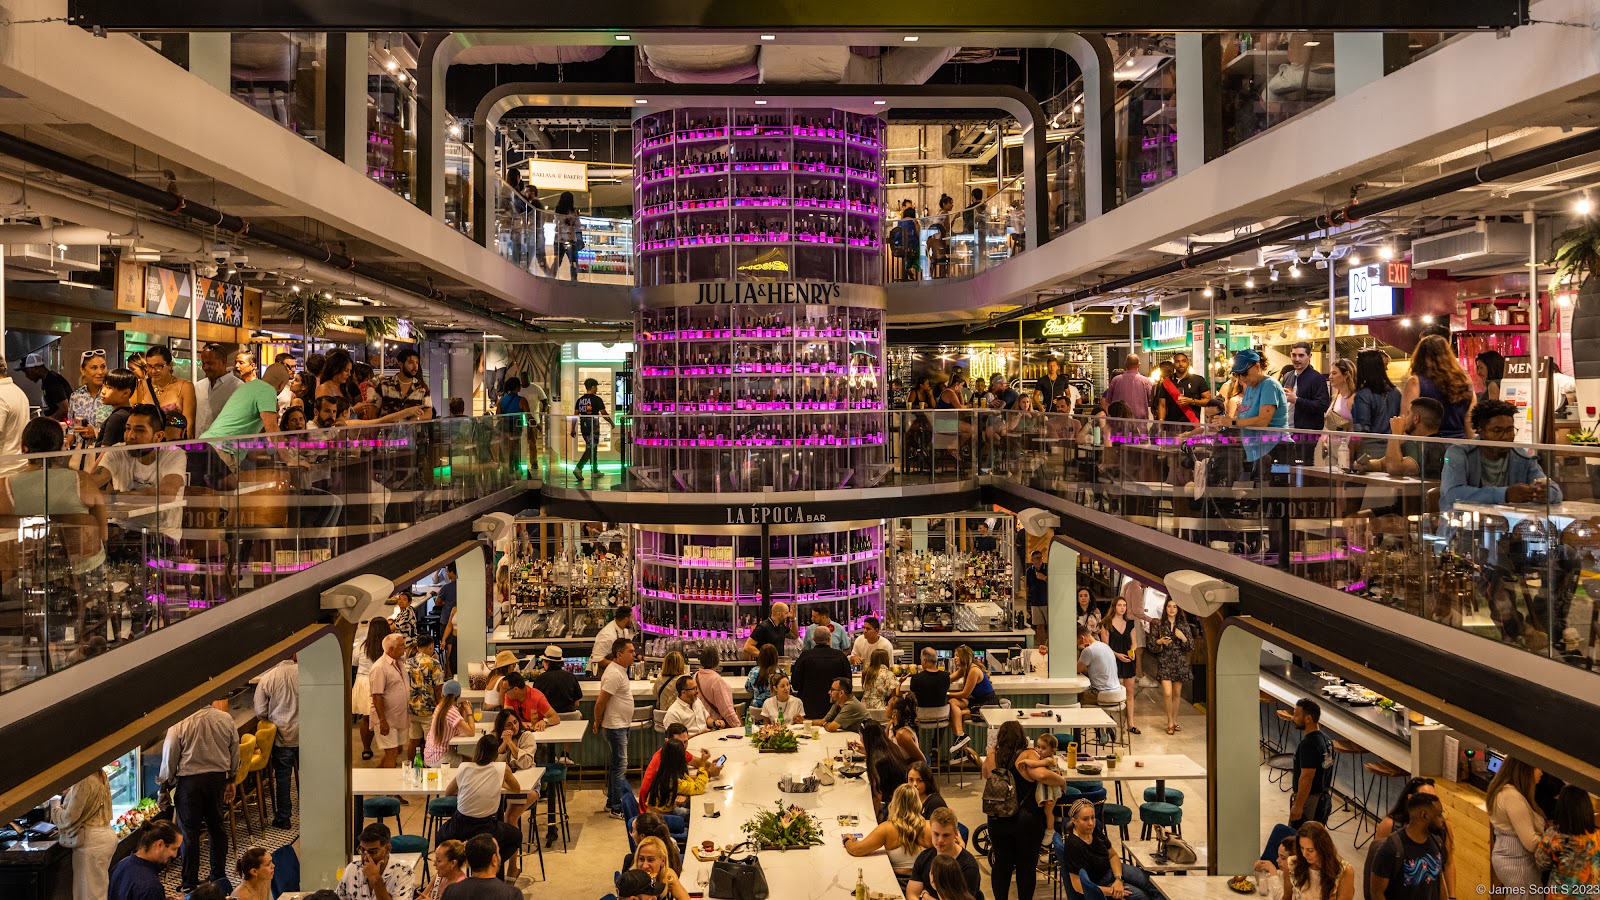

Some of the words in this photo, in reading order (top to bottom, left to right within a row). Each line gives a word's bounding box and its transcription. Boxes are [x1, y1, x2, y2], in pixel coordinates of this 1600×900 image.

[1388, 263, 1409, 284] EXIT
[726, 507, 745, 524] LA
[750, 502, 804, 524] ÉPOCA
[806, 514, 827, 522] BAR
